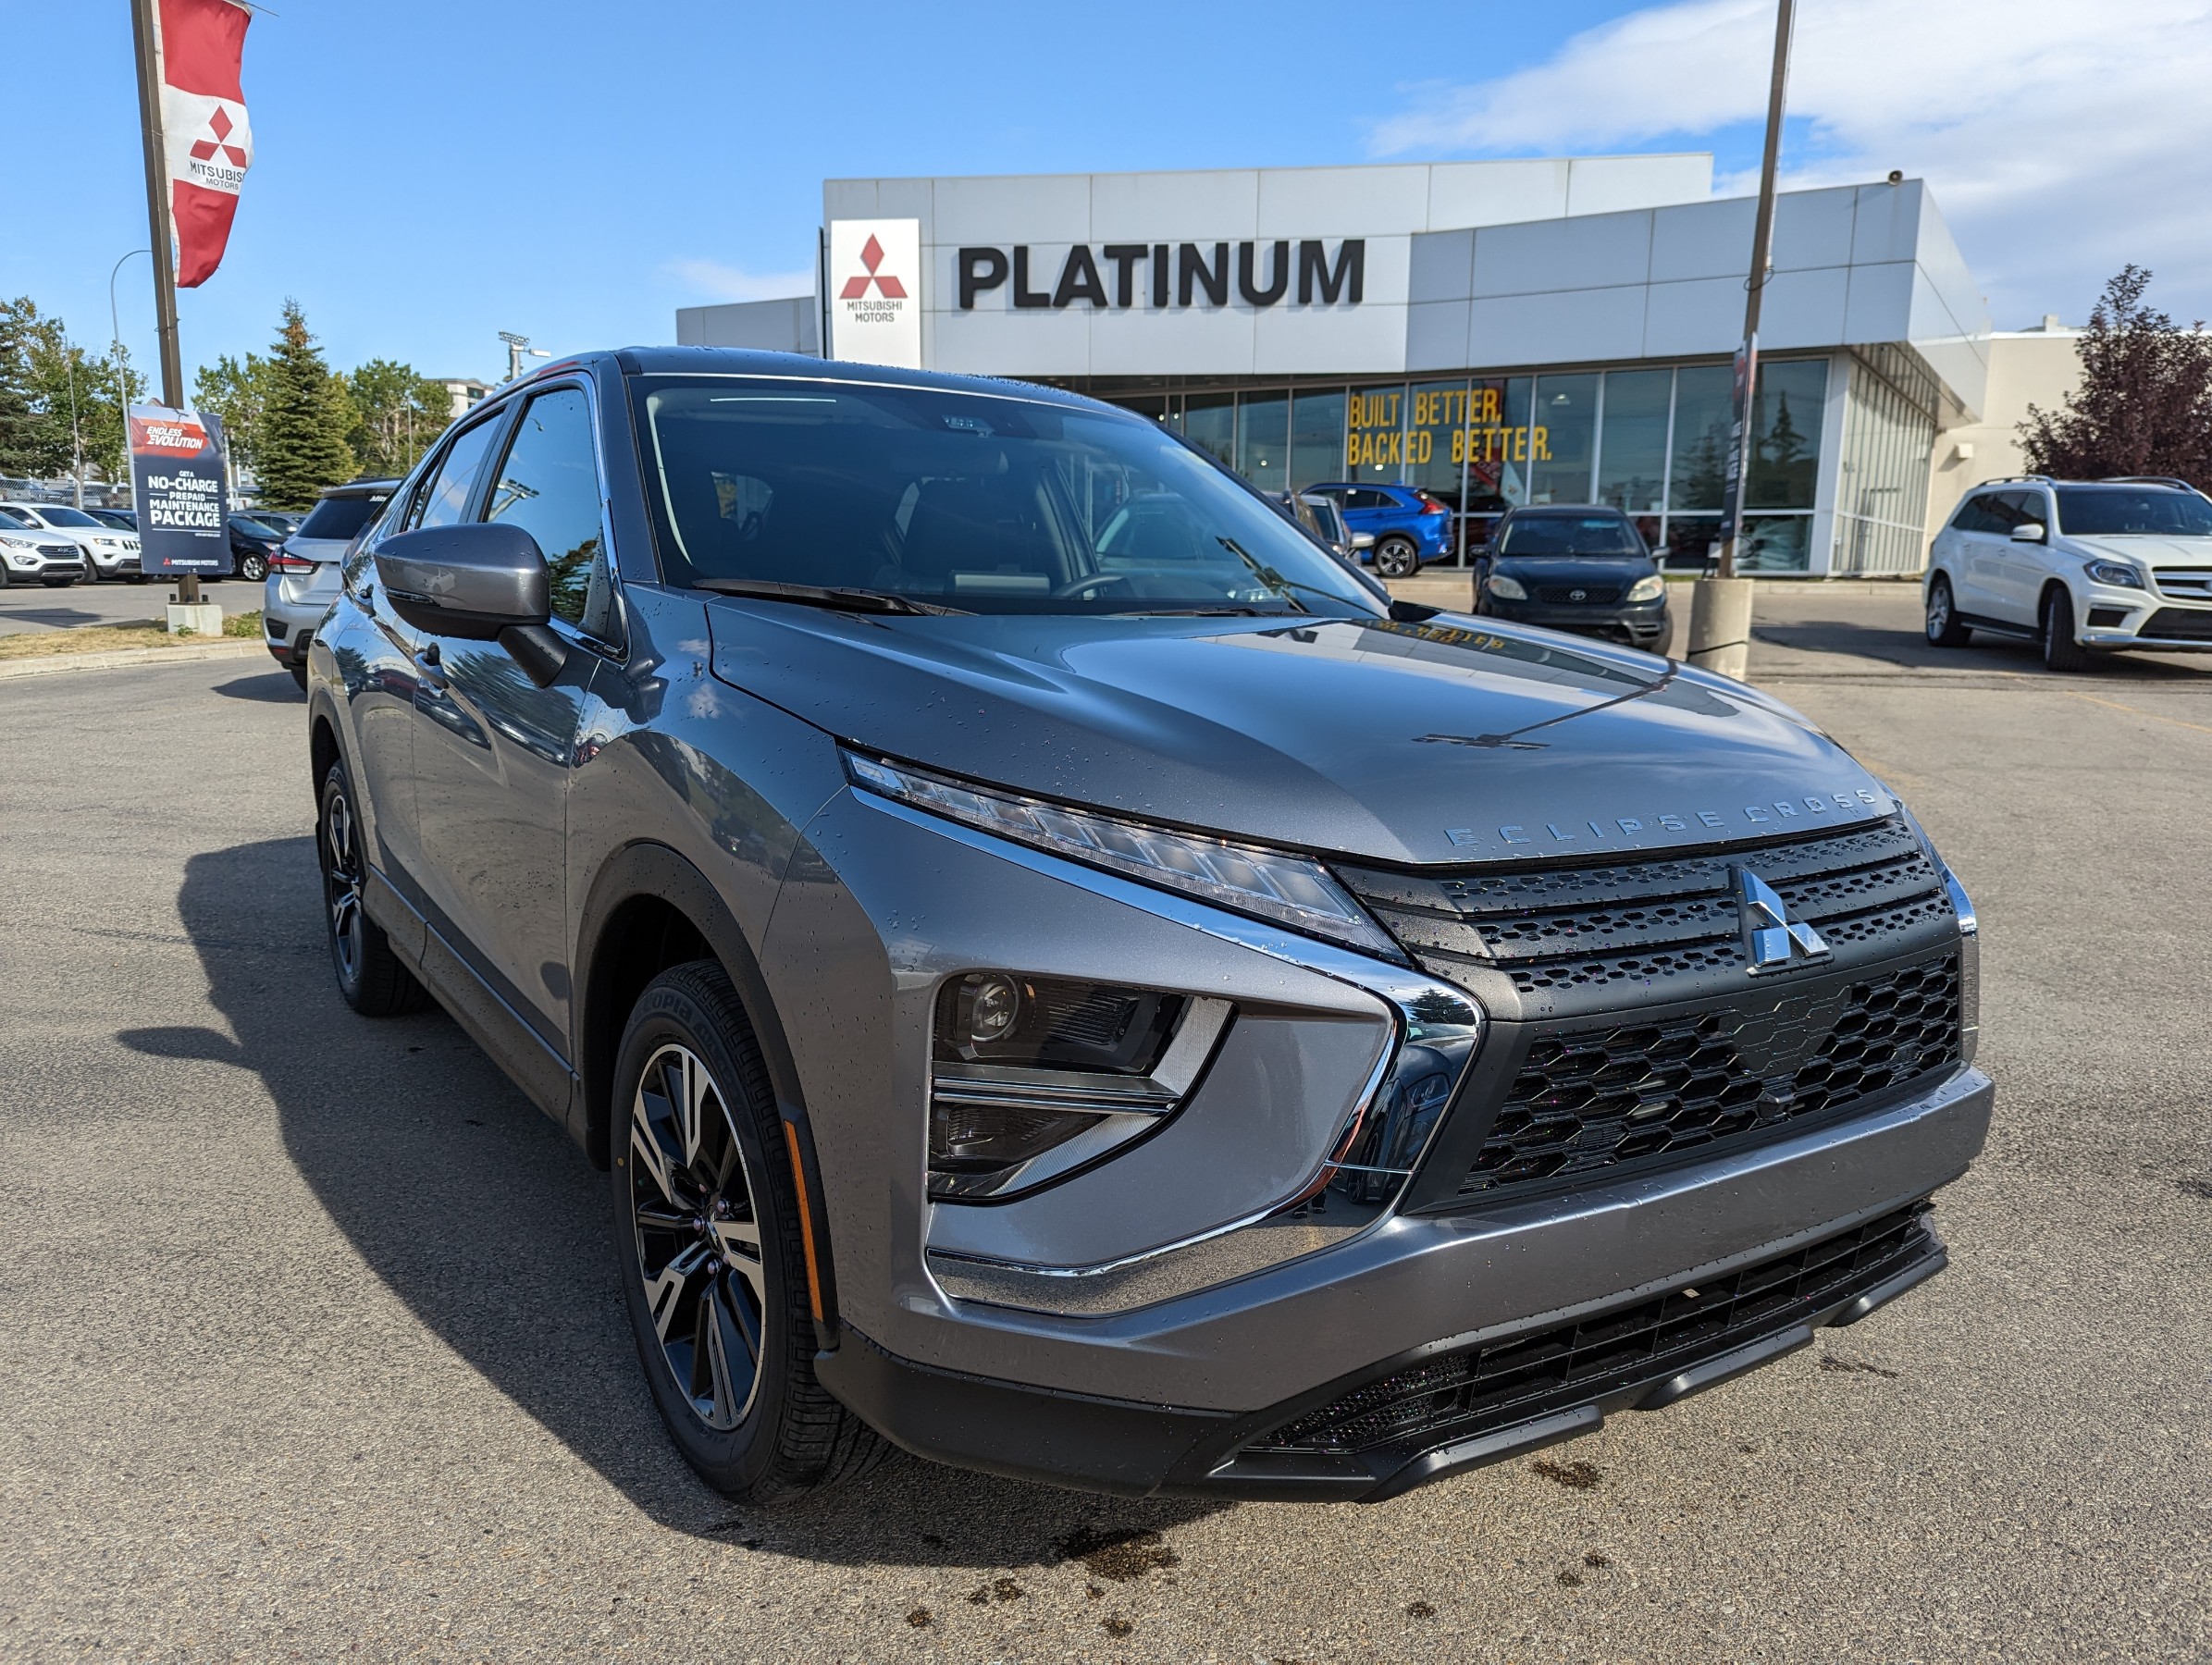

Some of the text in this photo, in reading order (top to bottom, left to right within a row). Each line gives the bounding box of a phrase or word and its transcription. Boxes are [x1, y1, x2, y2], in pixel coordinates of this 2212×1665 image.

[205, 178, 239, 190] MOTORS
[958, 240, 1365, 309] PLATINUM
[847, 301, 903, 312] MITSUBISHI
[855, 312, 895, 323] MOTORS
[1349, 388, 1501, 427] BUILT BETTER.
[146, 426, 182, 436] ENDLESS
[1349, 426, 1552, 465] BACKED BETTER.
[148, 475, 218, 493] NO-CHARGE
[169, 491, 205, 501] PREPAID
[150, 500, 219, 512] MAINTENANCE
[151, 510, 221, 527] PACKAGE
[1444, 788, 1876, 847] ECLIPSE CROSS
